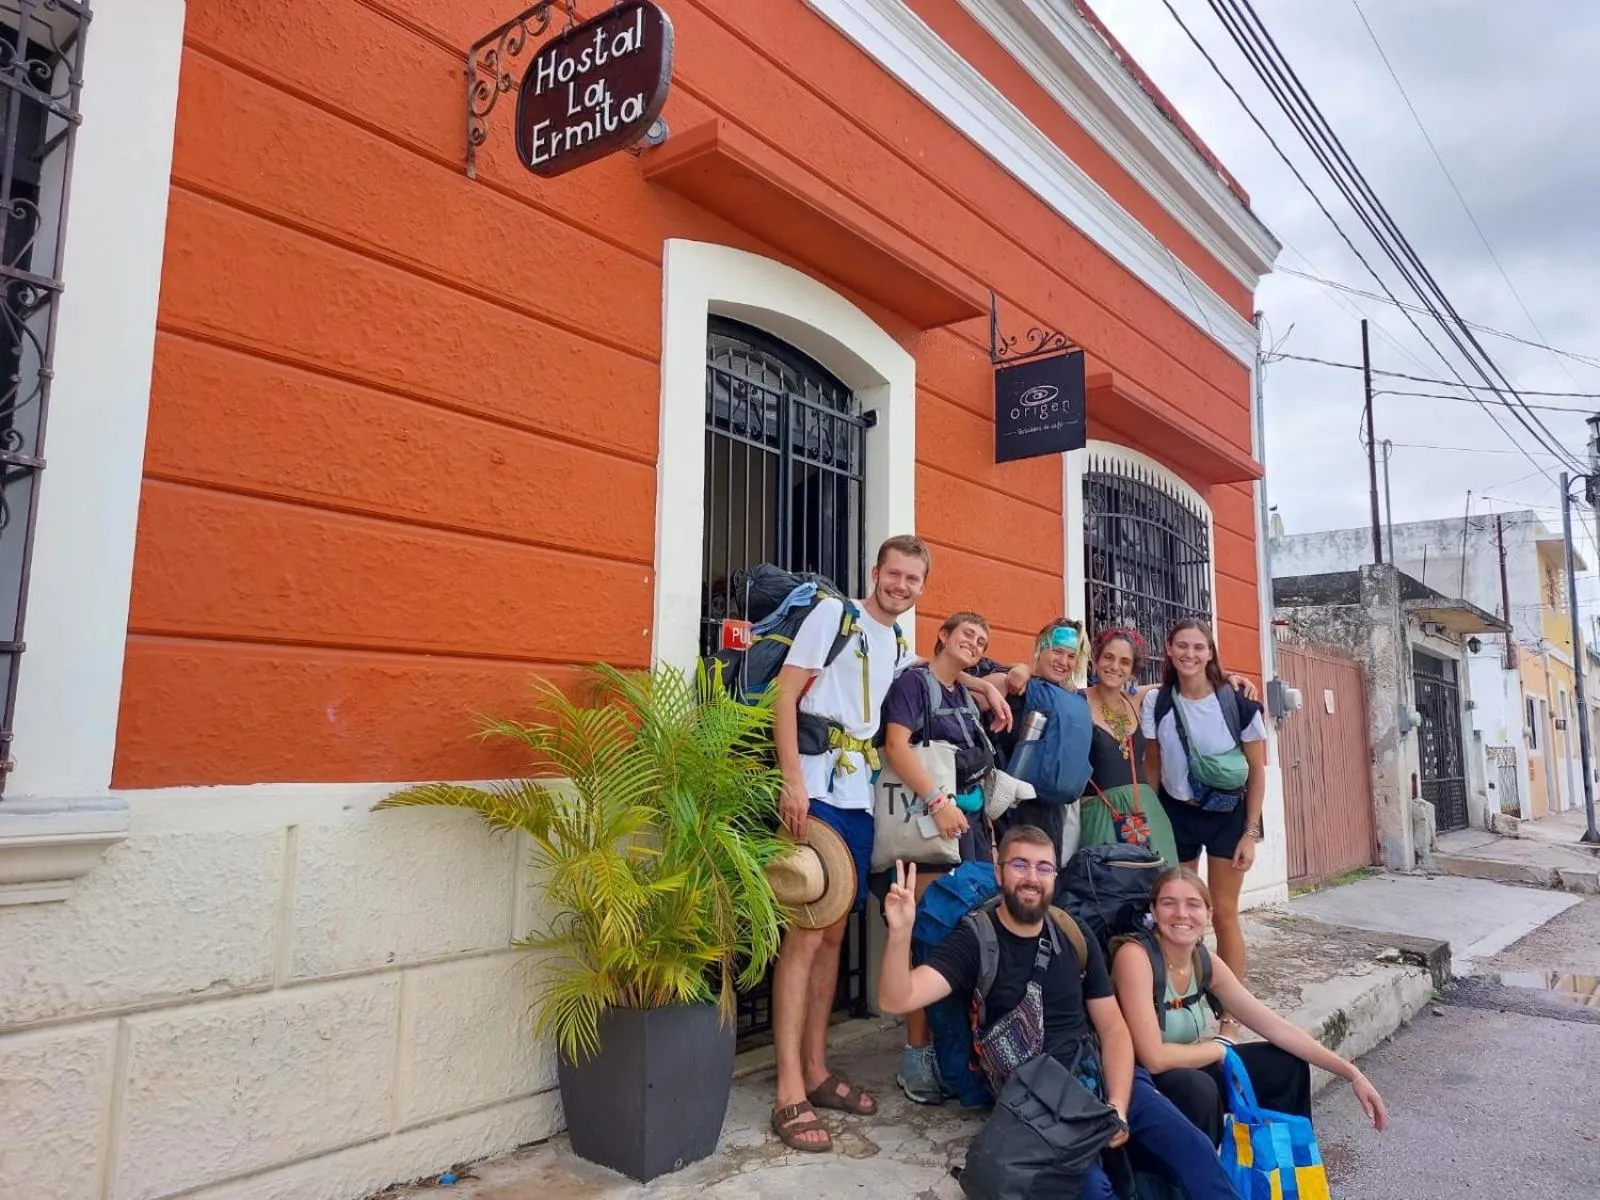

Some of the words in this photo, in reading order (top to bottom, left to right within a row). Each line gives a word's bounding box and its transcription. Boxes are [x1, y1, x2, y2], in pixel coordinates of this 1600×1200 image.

[535, 7, 643, 95] Hostal
[567, 78, 606, 117] La
[531, 92, 643, 166] Ermita
[1010, 400, 1070, 420] origen
[882, 782, 929, 824] Ty
